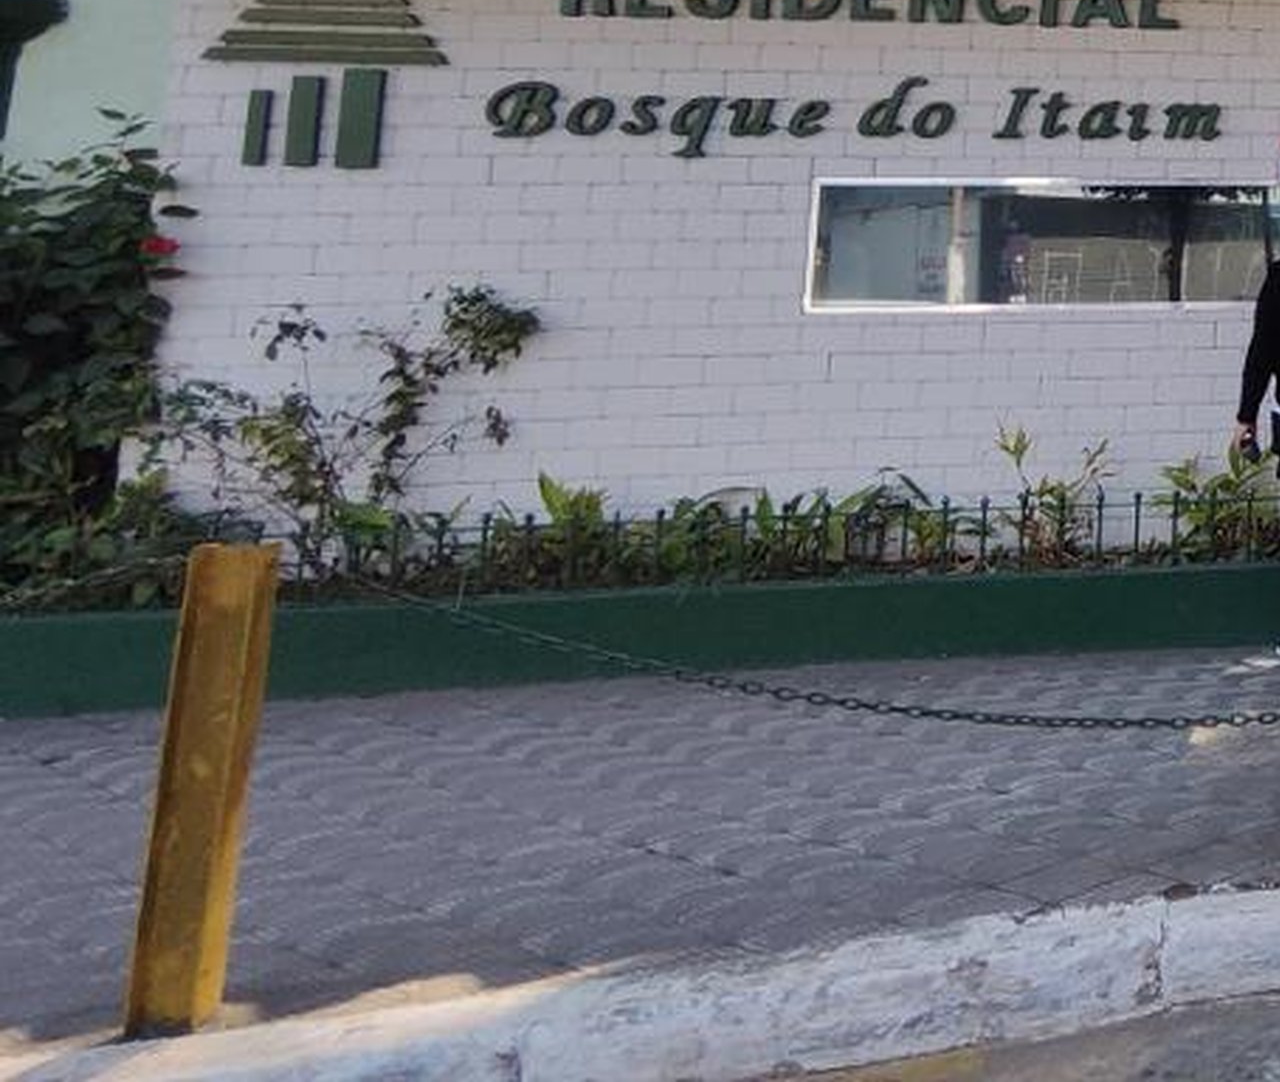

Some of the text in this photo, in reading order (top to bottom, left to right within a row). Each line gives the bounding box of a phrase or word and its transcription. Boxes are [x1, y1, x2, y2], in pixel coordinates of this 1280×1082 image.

[485, 75, 1222, 158] Bosque do Itaim
